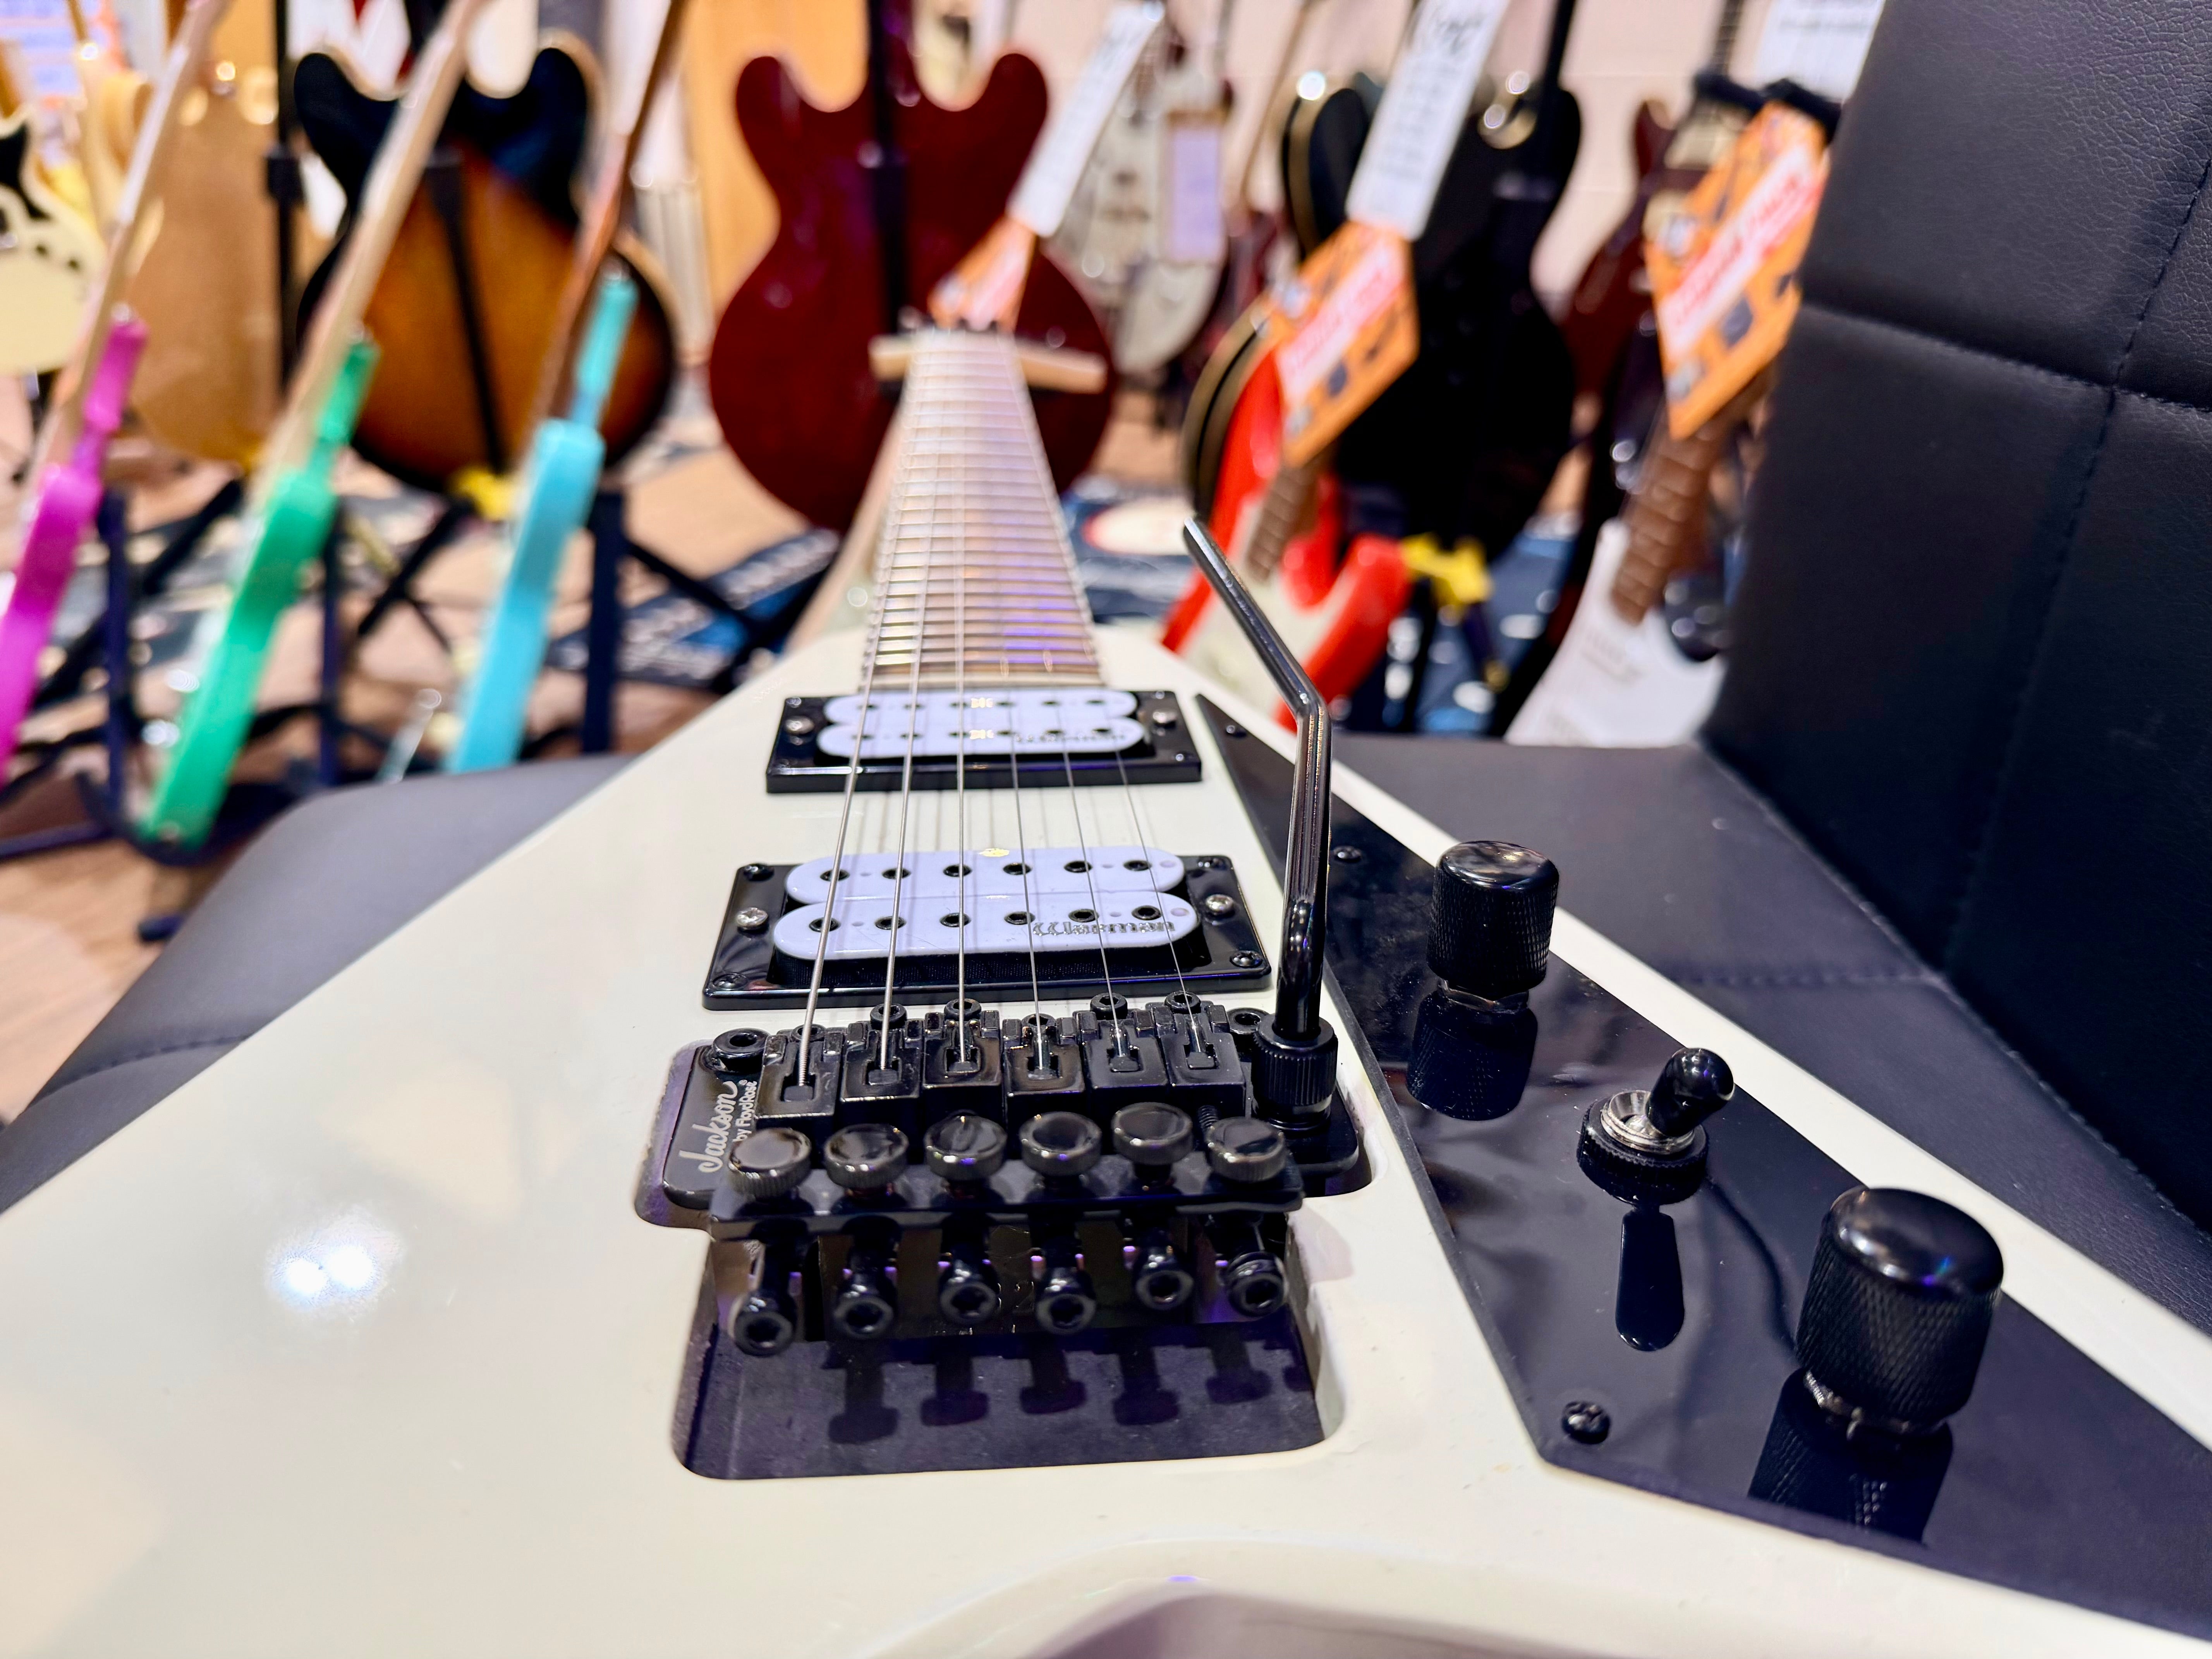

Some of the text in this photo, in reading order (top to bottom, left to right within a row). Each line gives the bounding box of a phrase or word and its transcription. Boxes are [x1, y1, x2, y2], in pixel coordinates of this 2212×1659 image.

[1033, 921, 1175, 936] Warman
[678, 1081, 738, 1173] Jackson
[732, 1128, 752, 1142] by
